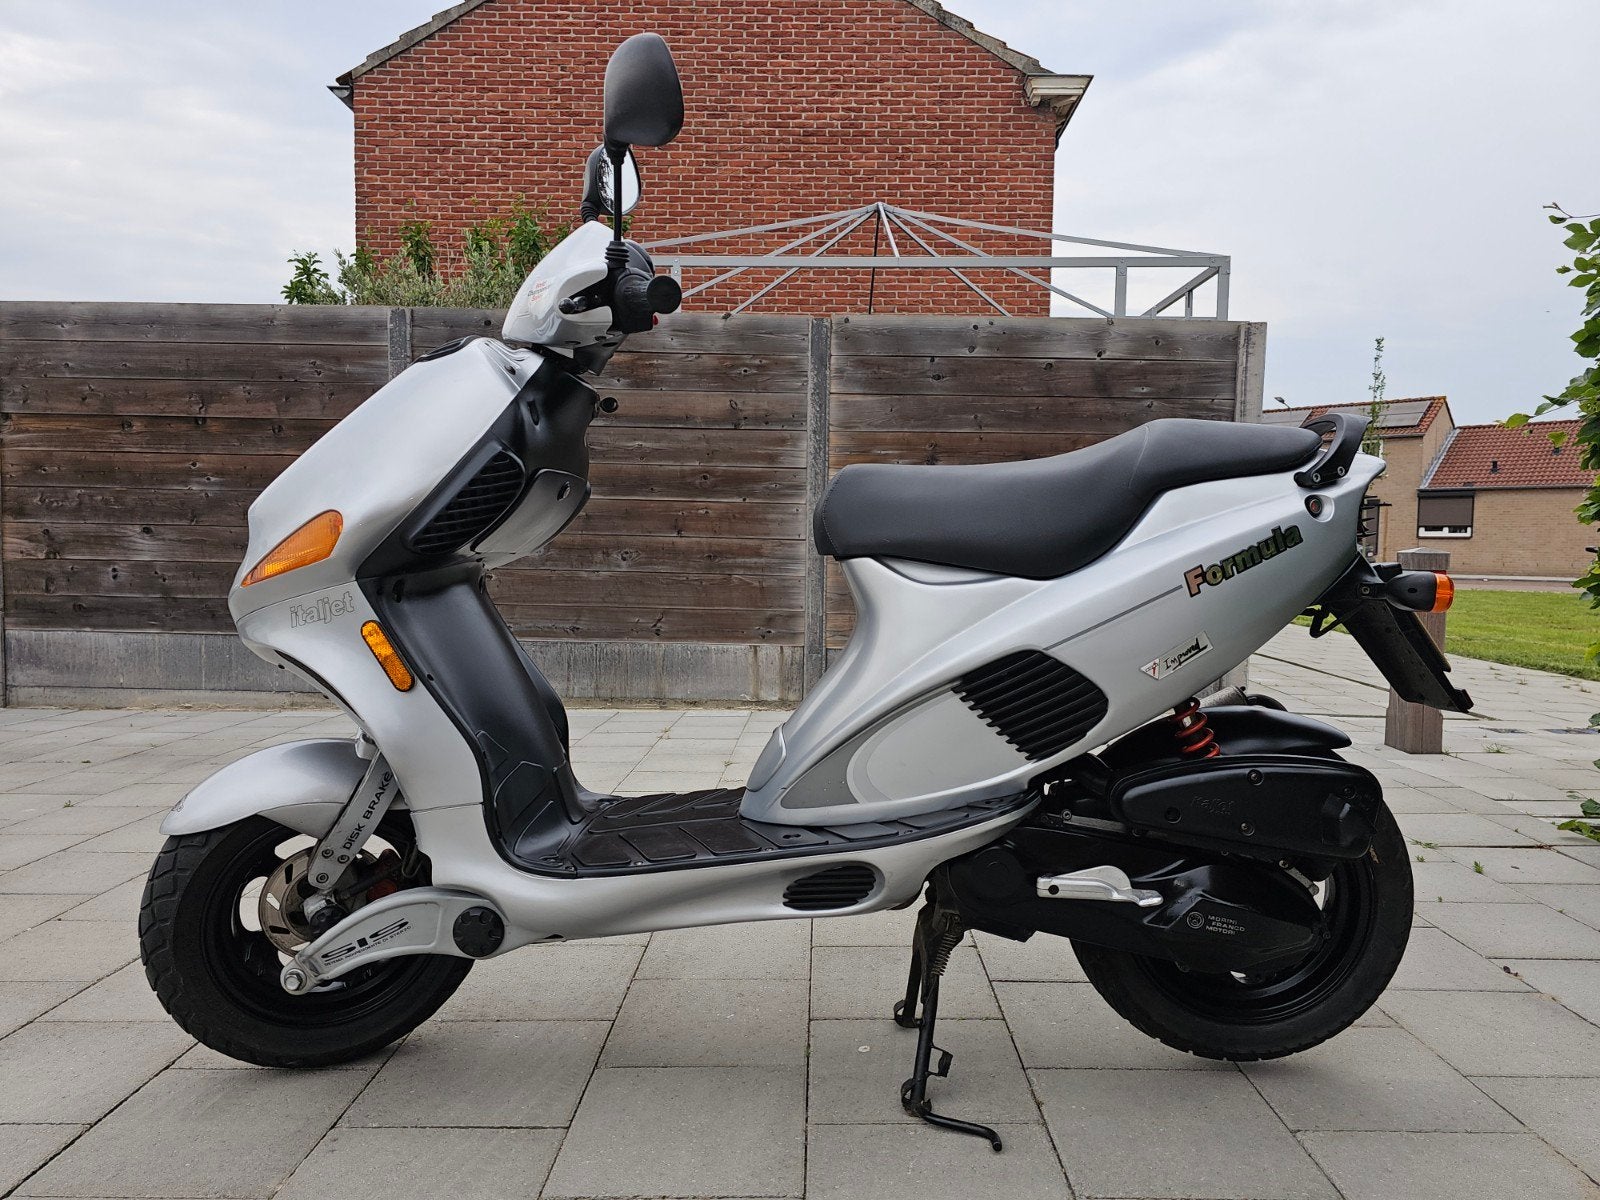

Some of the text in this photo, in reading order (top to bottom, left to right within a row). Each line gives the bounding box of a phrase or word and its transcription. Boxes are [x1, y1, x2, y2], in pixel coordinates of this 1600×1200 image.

[1183, 525, 1304, 598] Formula
[290, 591, 355, 628] italjet
[1163, 637, 1208, 671] Improved
[342, 771, 394, 850] DISK BRAKE
[1211, 921, 1245, 932] FRANCO
